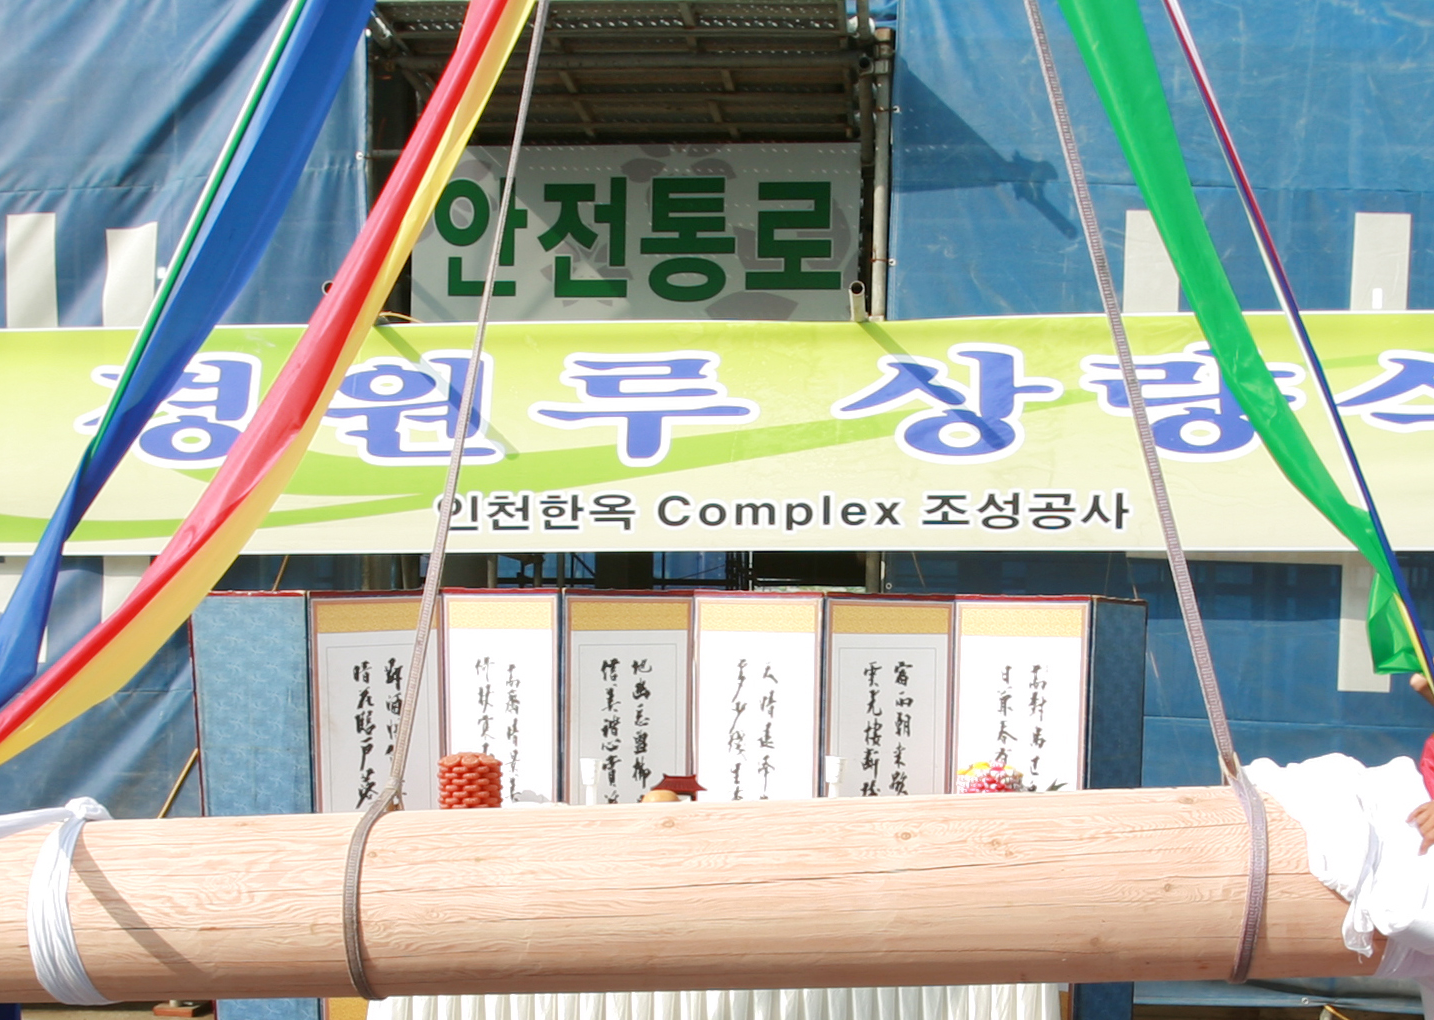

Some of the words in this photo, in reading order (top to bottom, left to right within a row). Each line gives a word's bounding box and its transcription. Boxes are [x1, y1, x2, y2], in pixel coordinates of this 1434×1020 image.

[435, 176, 842, 302] 안전통로
[438, 492, 635, 532] 인천한옥
[657, 494, 900, 533] Complex
[922, 492, 1128, 530] 조성공사
